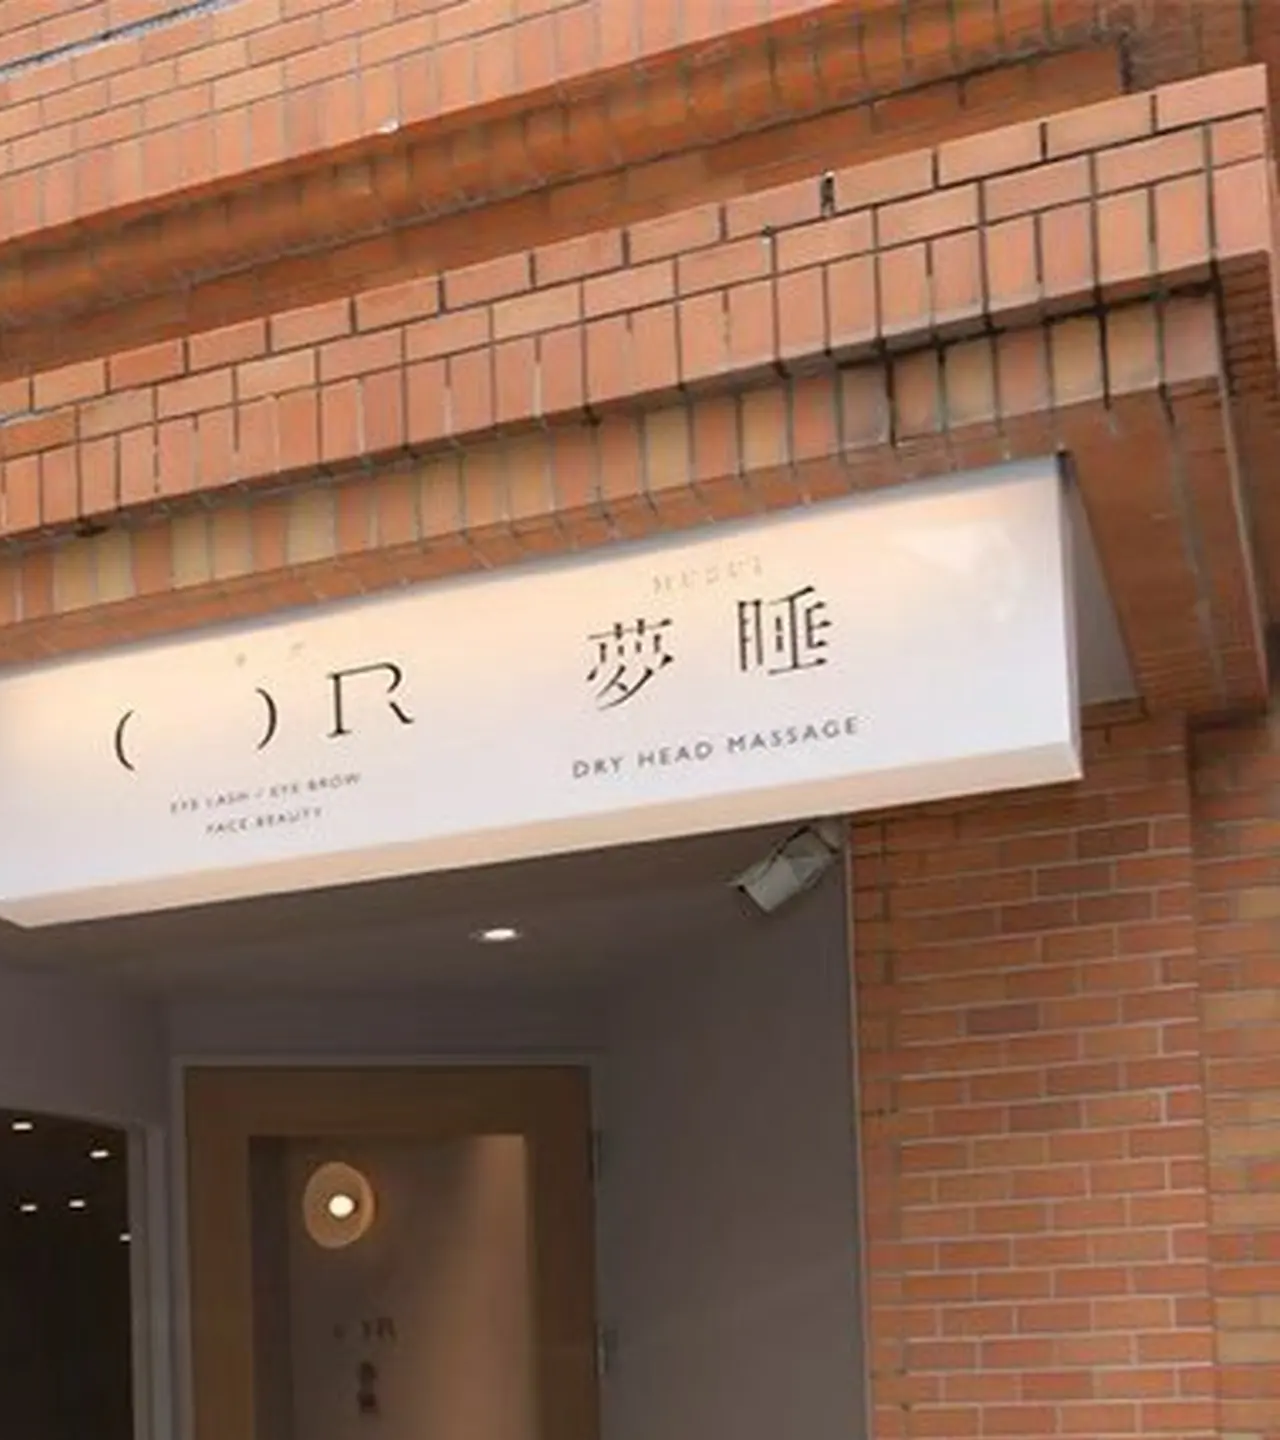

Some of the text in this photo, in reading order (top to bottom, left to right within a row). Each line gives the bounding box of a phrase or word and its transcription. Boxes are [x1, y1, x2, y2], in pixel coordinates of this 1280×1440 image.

[571, 715, 859, 780] DRY HEAD MASSAGE
[169, 798, 200, 815] EYE
[205, 790, 251, 809] LASH
[269, 782, 300, 799] EYE
[307, 772, 362, 792] BROW
[205, 806, 324, 836] FACE BEAUTY
